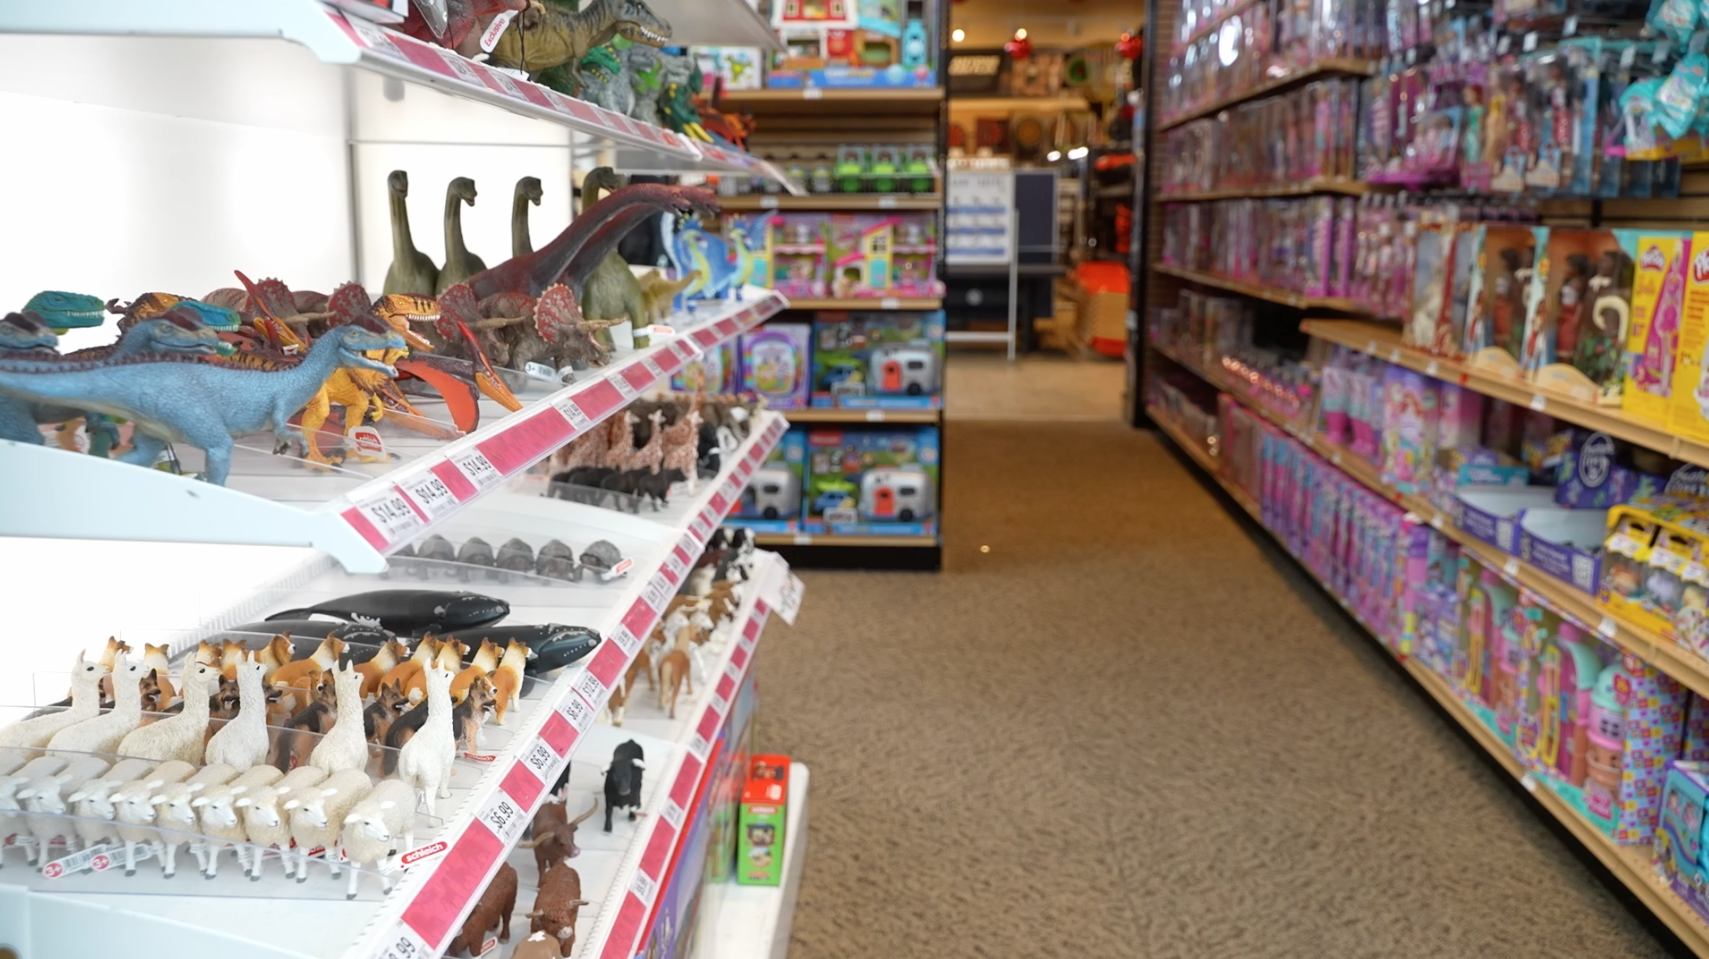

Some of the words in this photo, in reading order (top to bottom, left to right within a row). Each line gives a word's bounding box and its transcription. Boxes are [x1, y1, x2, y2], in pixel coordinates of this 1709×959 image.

[484, 18, 505, 47] Exclusive
[462, 455, 492, 477] $14.99
[415, 479, 448, 504] $14.99
[371, 498, 411, 523] $14.99
[530, 746, 550, 770] $6.99
[490, 801, 514, 829] $6.99
[93, 857, 109, 868] 3+
[406, 842, 443, 863] schleich
[46, 864, 62, 876] 3+
